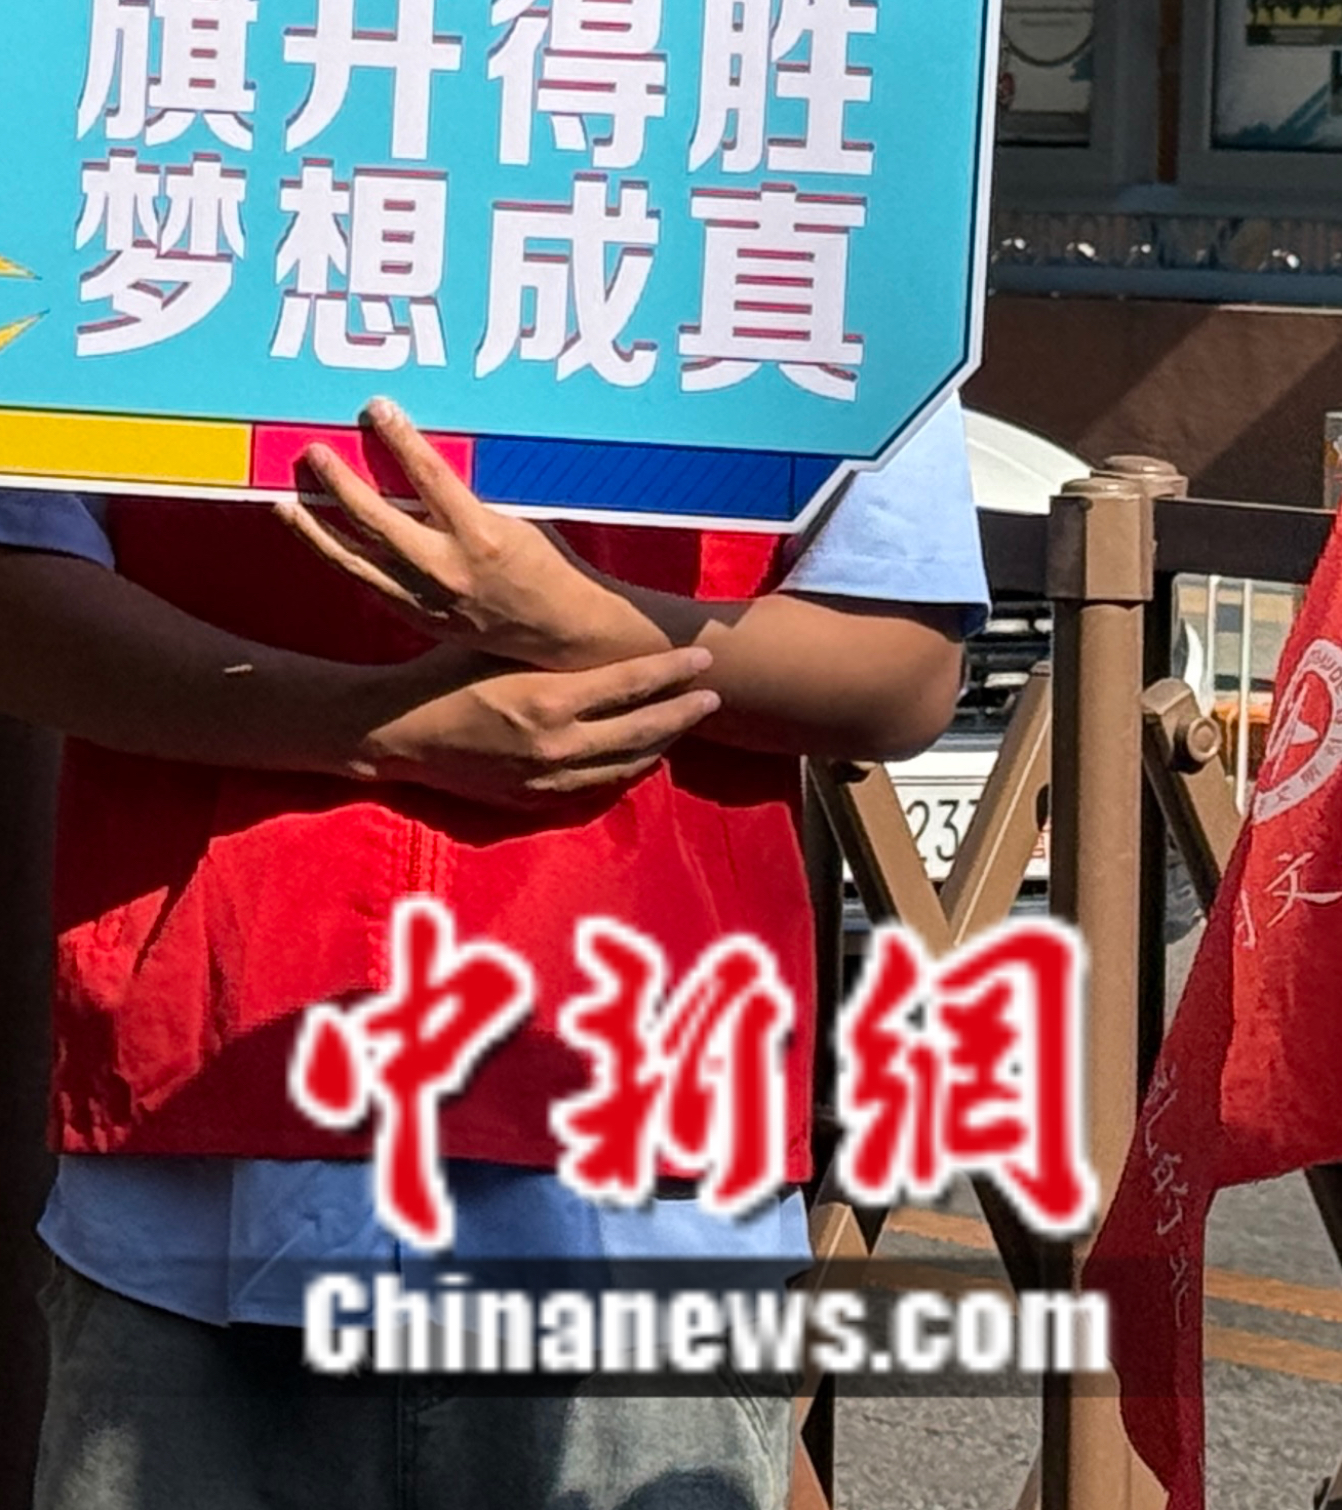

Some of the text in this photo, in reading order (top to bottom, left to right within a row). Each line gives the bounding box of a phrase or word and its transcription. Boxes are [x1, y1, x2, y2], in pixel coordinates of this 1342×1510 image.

[74, 150, 868, 403] 梦想成真
[906, 799, 980, 862] 23
